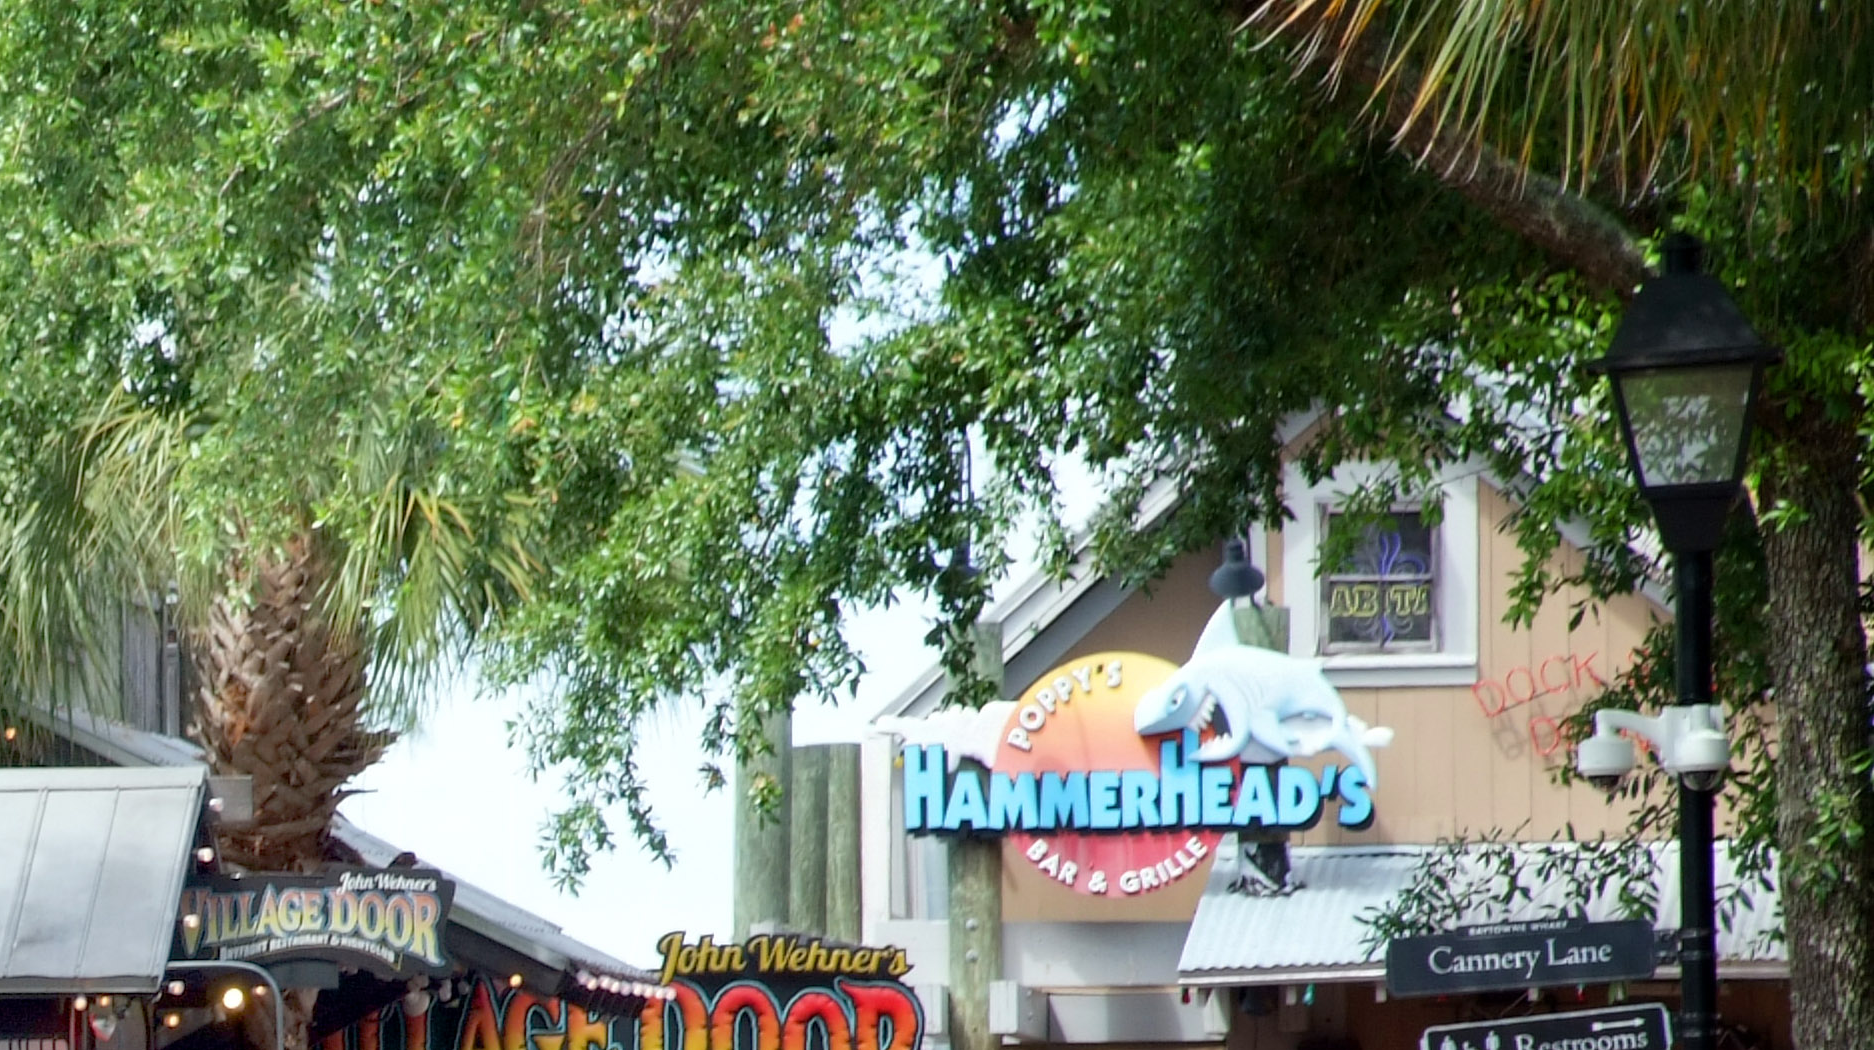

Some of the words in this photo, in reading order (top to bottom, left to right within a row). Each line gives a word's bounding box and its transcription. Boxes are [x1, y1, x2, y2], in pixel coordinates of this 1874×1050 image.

[1007, 660, 1123, 751] POPPY'S
[1472, 651, 1602, 717] DOCK
[904, 727, 1376, 832] HAMMERHEAD'S
[338, 872, 374, 894] John
[375, 872, 438, 892] Wehner's
[1026, 837, 1077, 886] BAR
[1088, 870, 1108, 895] &
[1119, 835, 1208, 895] GRILLE
[328, 888, 445, 966] DOOR
[657, 931, 747, 985] John
[748, 934, 915, 977] Wehner's
[1428, 945, 1540, 978] Cannery
[1546, 938, 1613, 967] Lane
